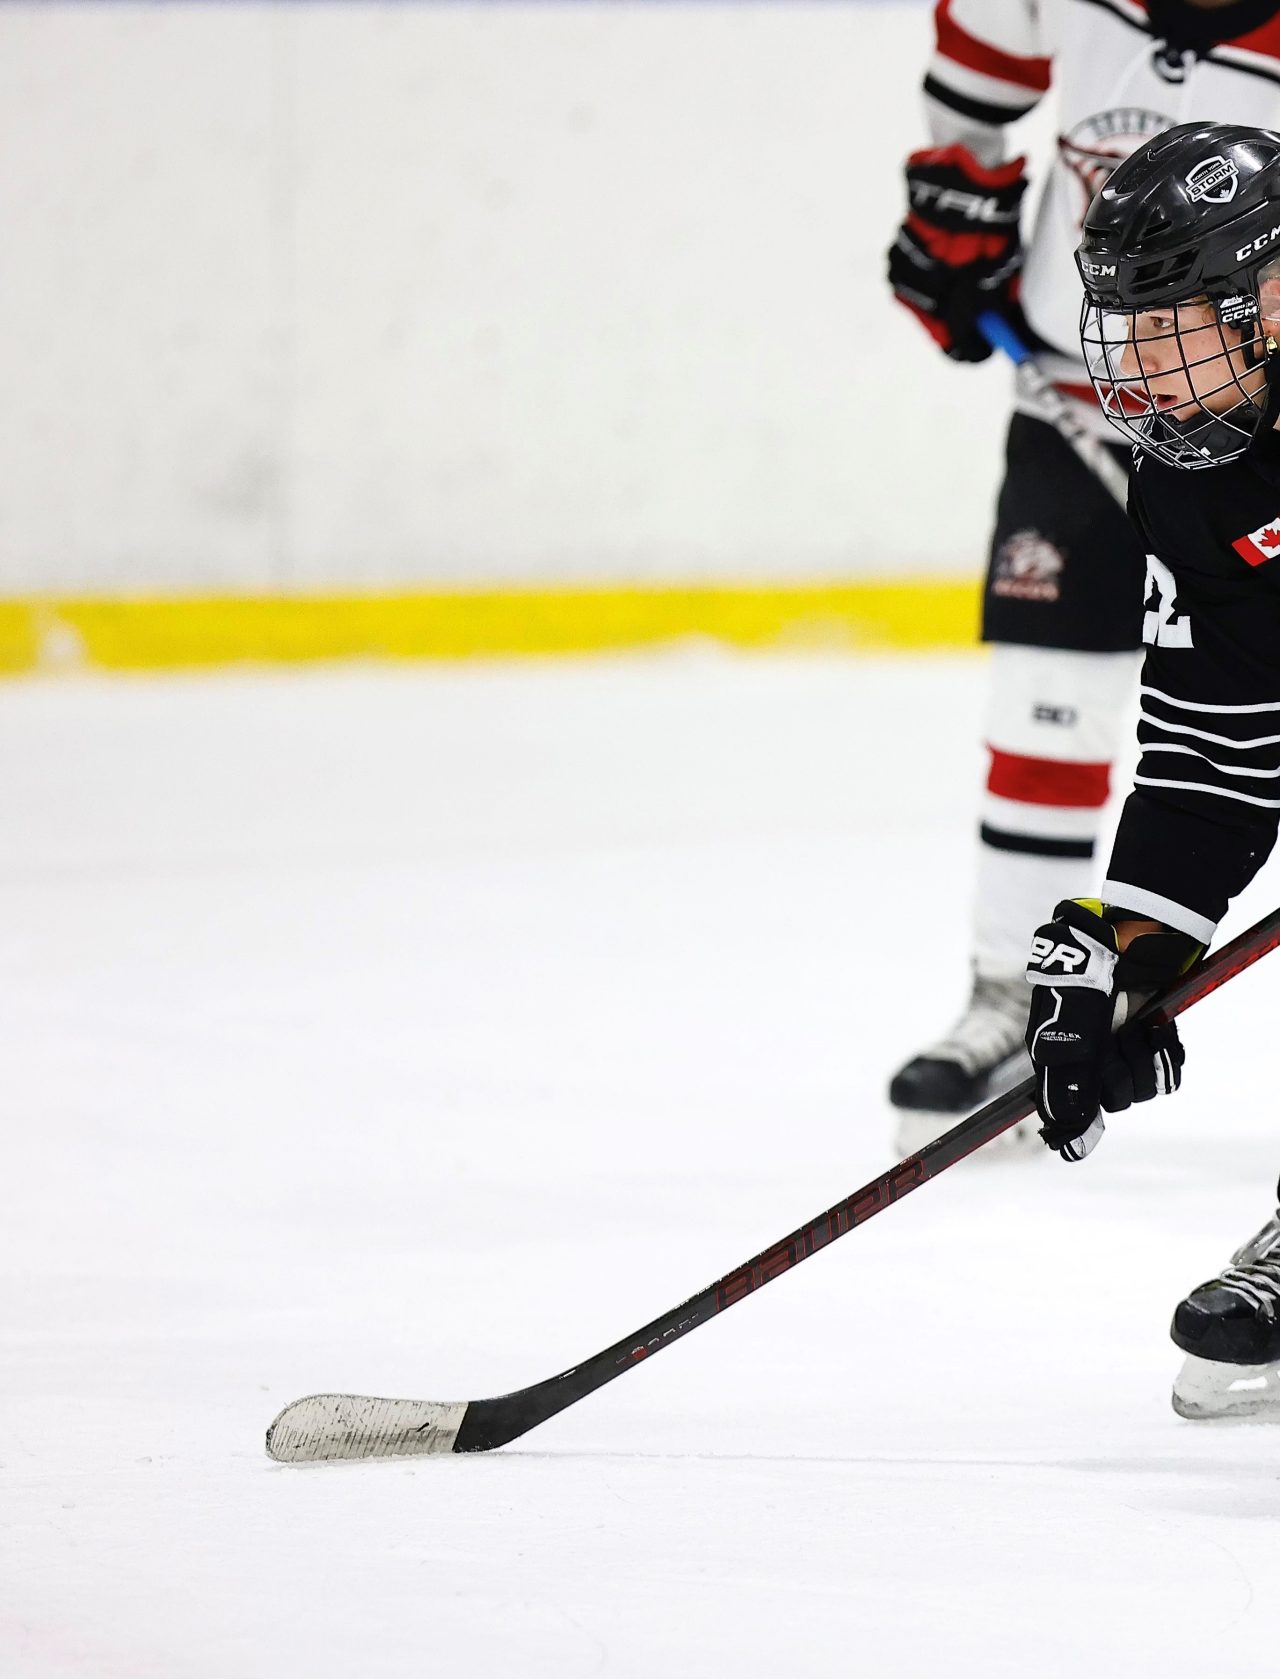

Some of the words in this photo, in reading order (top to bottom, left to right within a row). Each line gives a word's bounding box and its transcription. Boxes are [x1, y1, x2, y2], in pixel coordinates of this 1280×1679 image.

[1191, 164, 1235, 196] STORM
[1192, 169, 1208, 182] NORTH
[1081, 260, 1116, 277] CCM
[1222, 305, 1258, 323] CCM
[1058, 1031, 1082, 1039] FLEX
